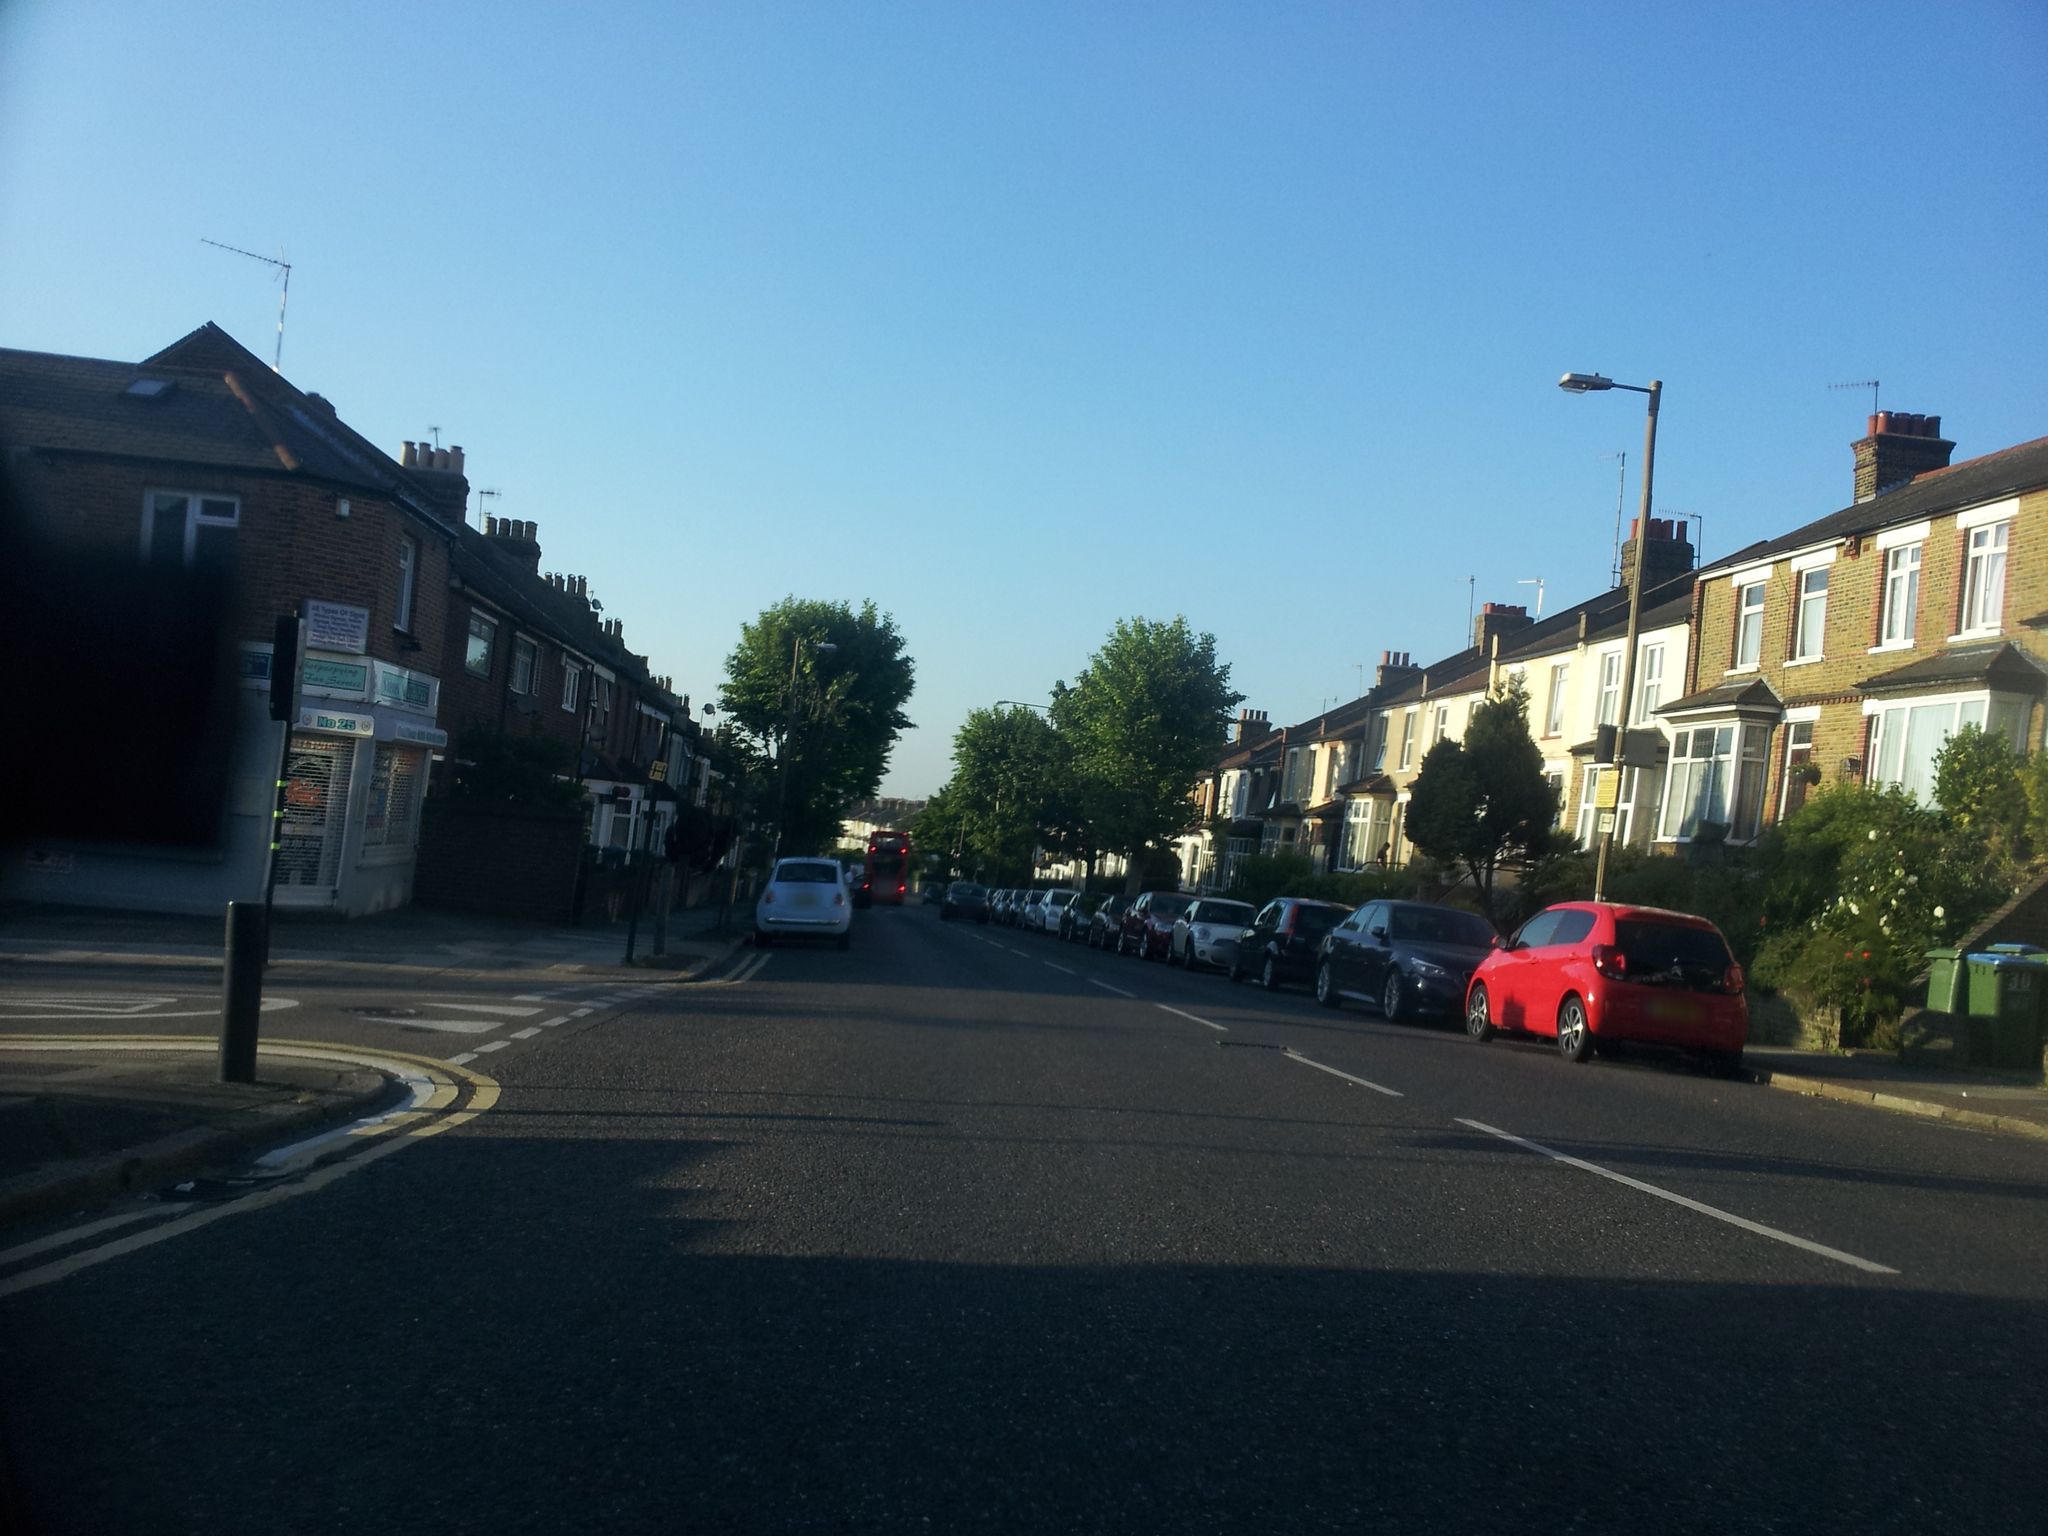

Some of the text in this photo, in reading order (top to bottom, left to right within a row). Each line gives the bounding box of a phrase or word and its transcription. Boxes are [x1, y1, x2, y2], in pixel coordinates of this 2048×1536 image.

[317, 715, 356, 731] No 25
[651, 762, 666, 779] H
